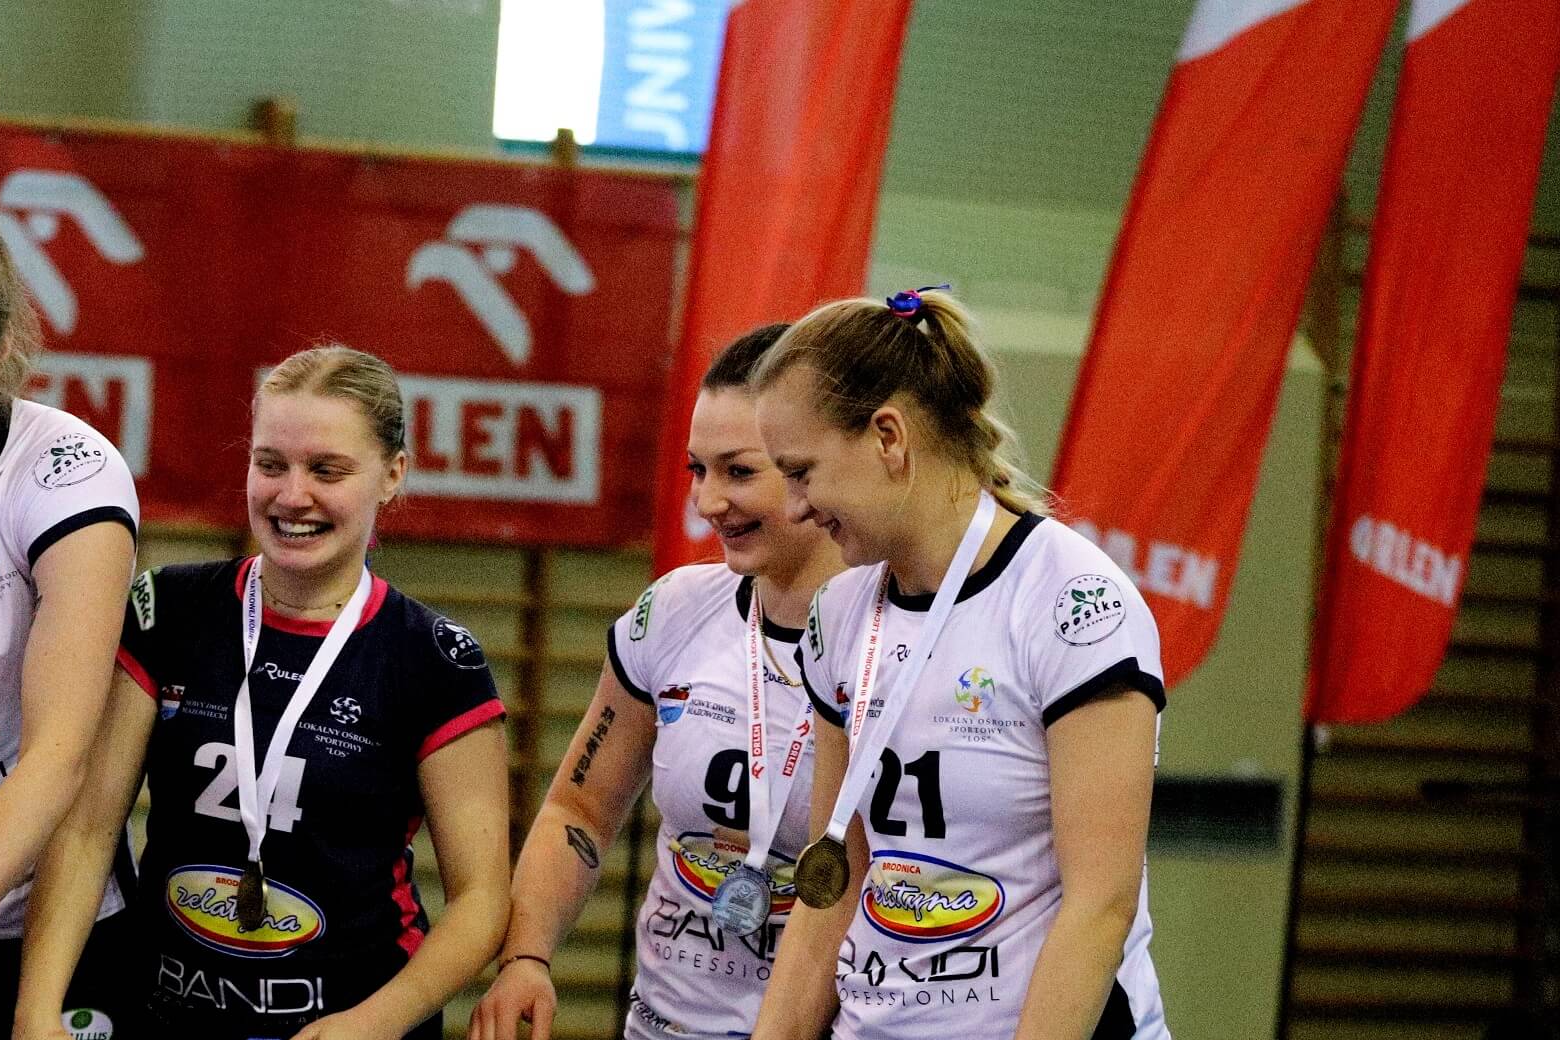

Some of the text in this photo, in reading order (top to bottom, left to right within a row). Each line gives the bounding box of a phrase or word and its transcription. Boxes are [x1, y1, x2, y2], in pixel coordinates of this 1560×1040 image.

[412, 394, 576, 483] LEN
[1059, 598, 1122, 635] Pestka
[853, 701, 866, 736] ORLEN
[873, 605, 883, 633] LECHA
[298, 721, 340, 739] LOKALNY
[314, 734, 363, 752] SPORTOWY
[752, 723, 762, 757] ORLEN
[782, 741, 803, 778] ORLEN
[193, 741, 308, 833] 24
[702, 748, 750, 831] 9
[869, 748, 947, 840] 21
[215, 876, 240, 887] BROD
[881, 861, 922, 875] BRODNICA
[872, 879, 978, 922] elatyna
[646, 895, 786, 963] BAND
[653, 942, 771, 981] ROFESSIO
[158, 953, 325, 1014] BANDI
[840, 986, 1001, 1007] OFESSIONAL
